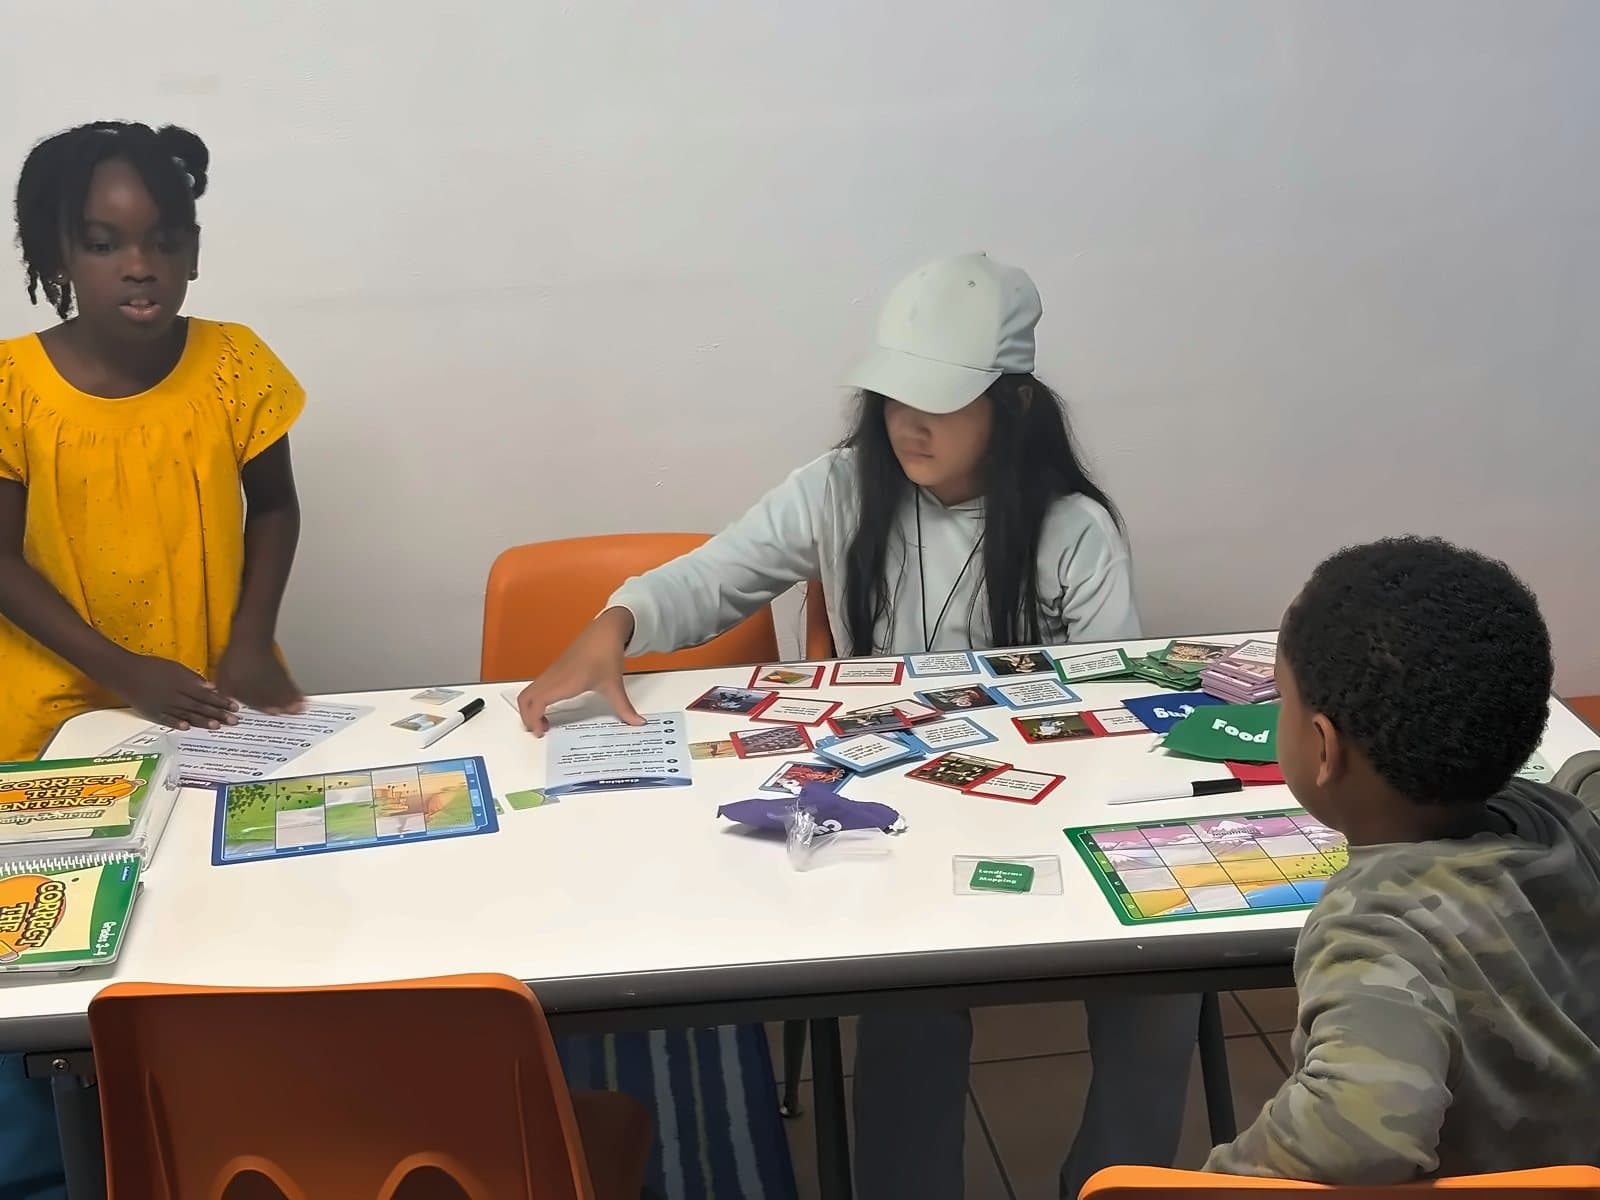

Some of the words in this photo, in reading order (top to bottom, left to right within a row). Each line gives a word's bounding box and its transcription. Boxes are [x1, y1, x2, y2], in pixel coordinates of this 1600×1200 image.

[1212, 718, 1270, 743] Food
[93, 755, 132, 763] Grades
[0, 774, 123, 792] CORRECT
[26, 787, 82, 799] THE
[0, 796, 113, 812] ENTENCE
[0, 902, 29, 933] THE
[17, 881, 66, 947] CORRECT
[97, 921, 118, 942] Grades
[93, 942, 110, 956] 3-4
